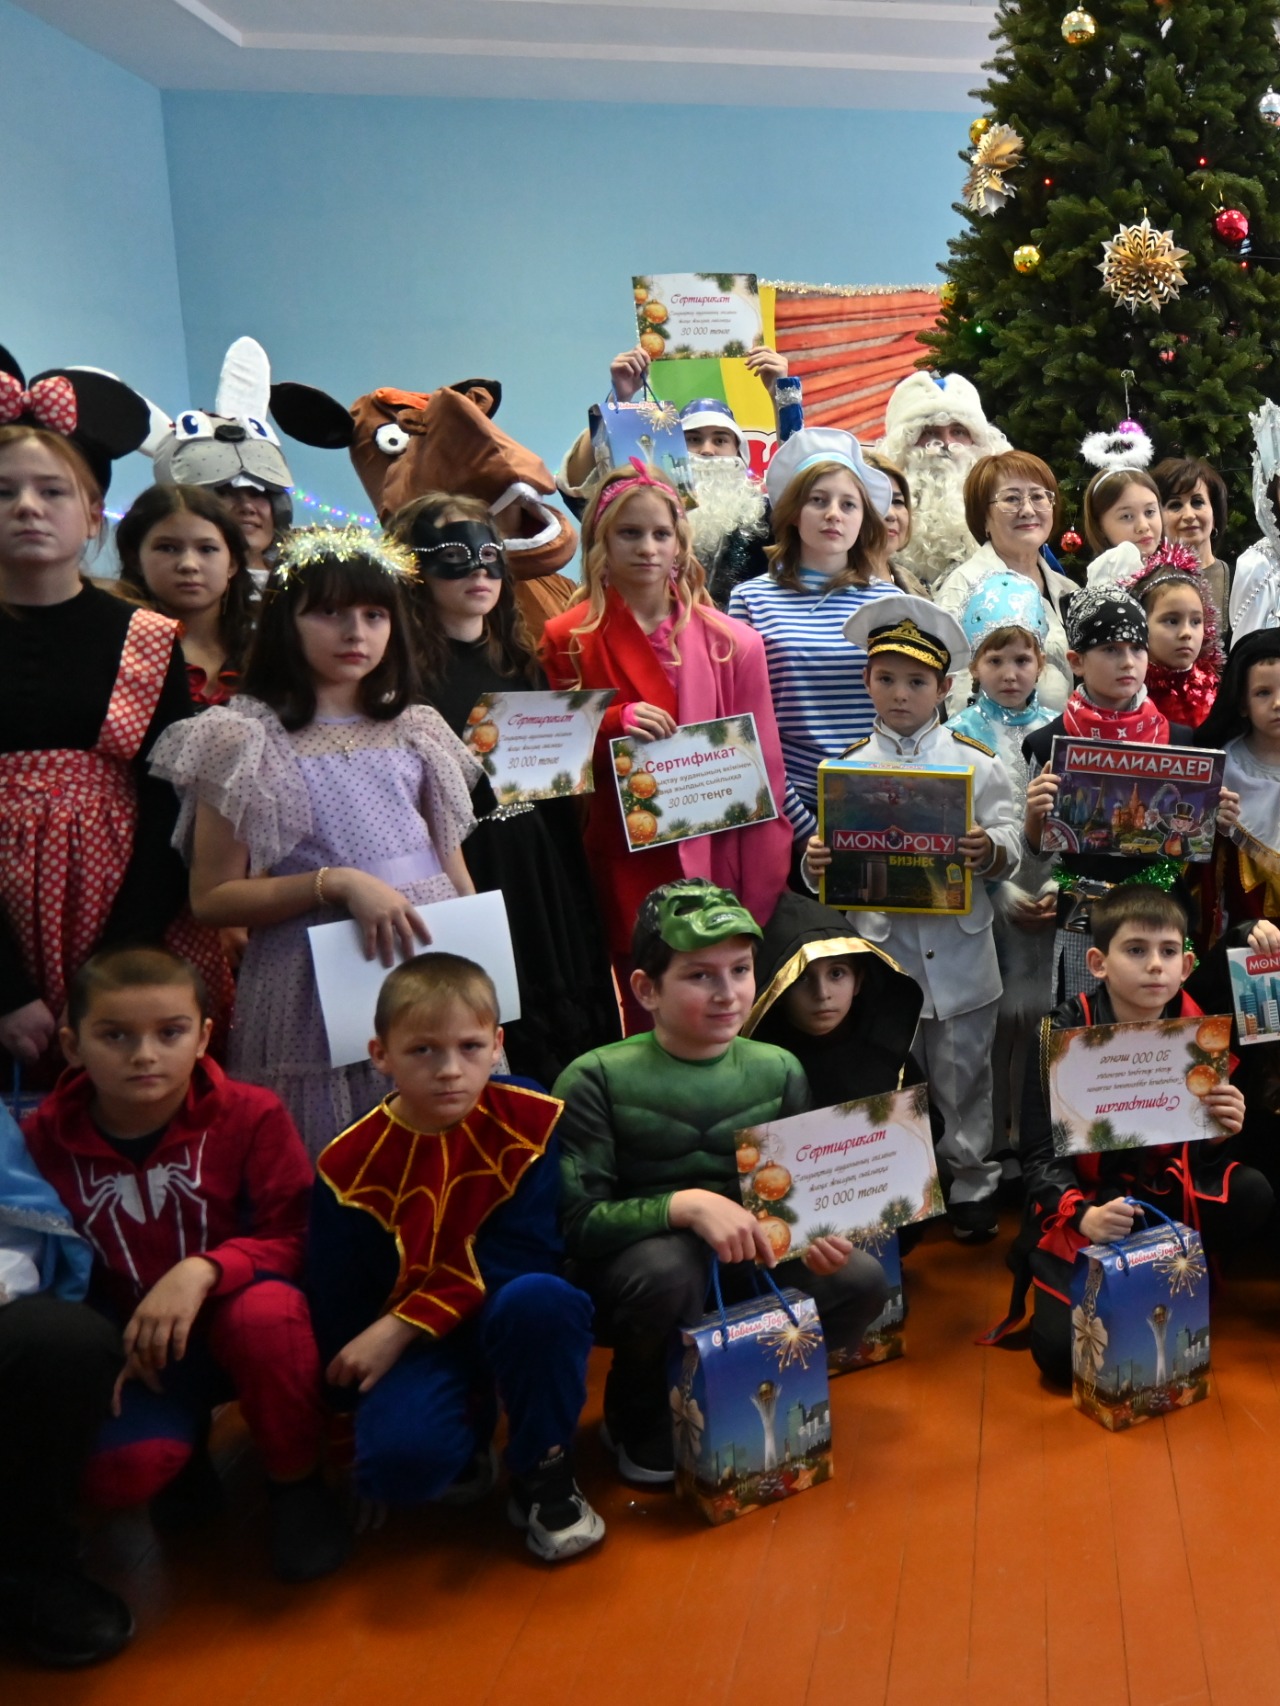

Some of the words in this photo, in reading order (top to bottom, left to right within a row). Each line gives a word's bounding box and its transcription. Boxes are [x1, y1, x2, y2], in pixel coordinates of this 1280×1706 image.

[671, 294, 730, 306] Сертификат
[681, 327, 691, 336] 30
[693, 326, 708, 335] 000
[507, 712, 575, 728] Сертификат
[507, 757, 519, 768] 30
[520, 756, 536, 768] 000
[645, 746, 736, 774] Сертификат
[1070, 751, 1210, 776] МИЛЛИАРДЕР
[668, 796, 681, 809] 30
[681, 793, 699, 807] 000
[700, 786, 732, 802] теңге
[836, 833, 952, 851] MONOPOLY
[889, 855, 935, 867] БИЗНЕС
[1132, 1051, 1154, 1065] 000
[1156, 1049, 1172, 1062] 30
[1095, 1092, 1181, 1114] Сертификат
[795, 1129, 887, 1164] Сертификат
[814, 1195, 829, 1212] 30
[833, 1188, 854, 1206] 000
